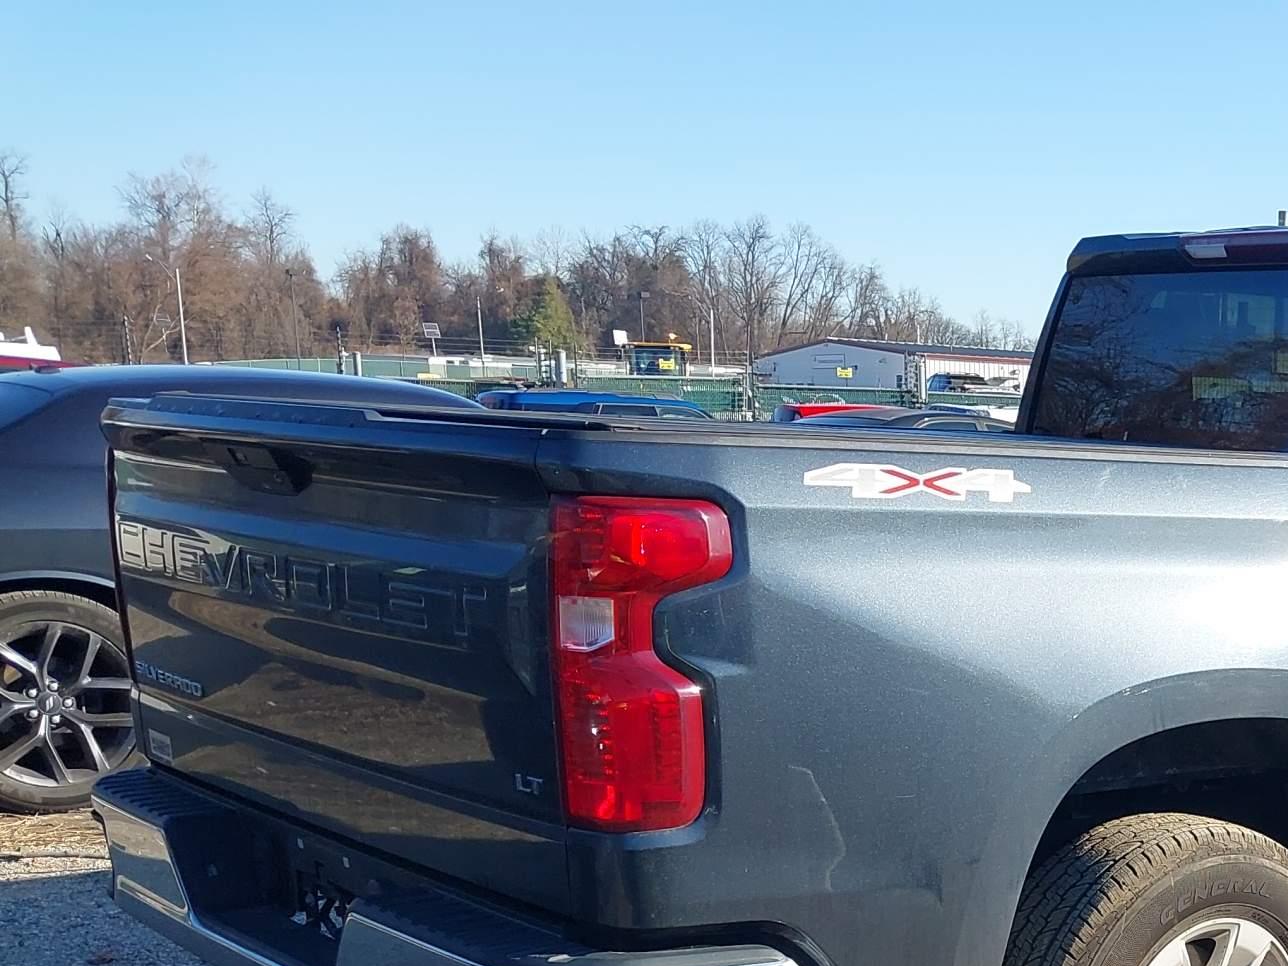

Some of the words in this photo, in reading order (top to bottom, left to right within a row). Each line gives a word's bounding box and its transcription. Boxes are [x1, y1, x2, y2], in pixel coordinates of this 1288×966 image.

[118, 520, 488, 638] CHEVROLET
[135, 660, 203, 697] SILVERADO
[514, 773, 543, 796] LT
[1160, 878, 1273, 926] GENERAL
